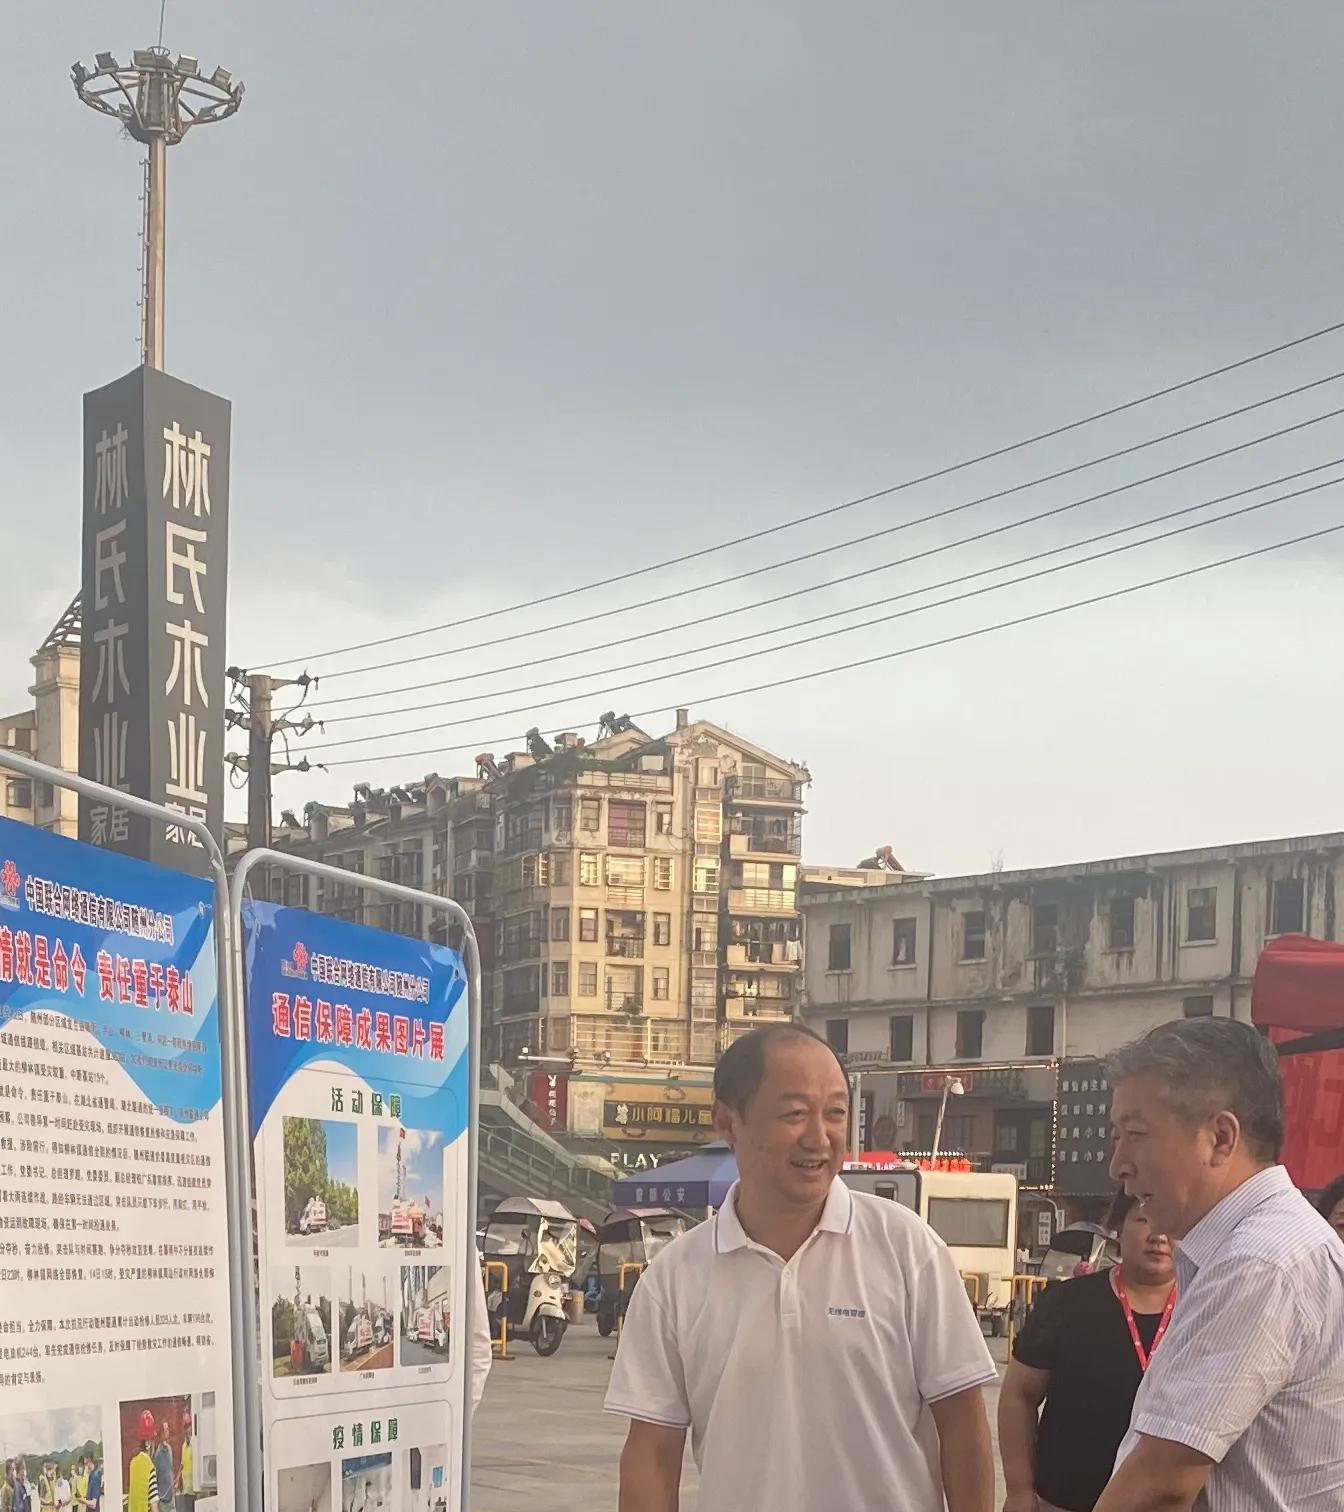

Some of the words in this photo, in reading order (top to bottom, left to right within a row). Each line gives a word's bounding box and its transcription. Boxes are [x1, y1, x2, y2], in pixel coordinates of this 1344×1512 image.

[93, 423, 130, 794] 林氏木业
[162, 421, 212, 803] 林氏木业
[97, 949, 194, 1016] 责任重于泰山
[272, 993, 446, 1061] 通信保障成果图片展
[331, 1087, 401, 1118] 活动保障
[332, 1417, 399, 1450] 疫情保障
